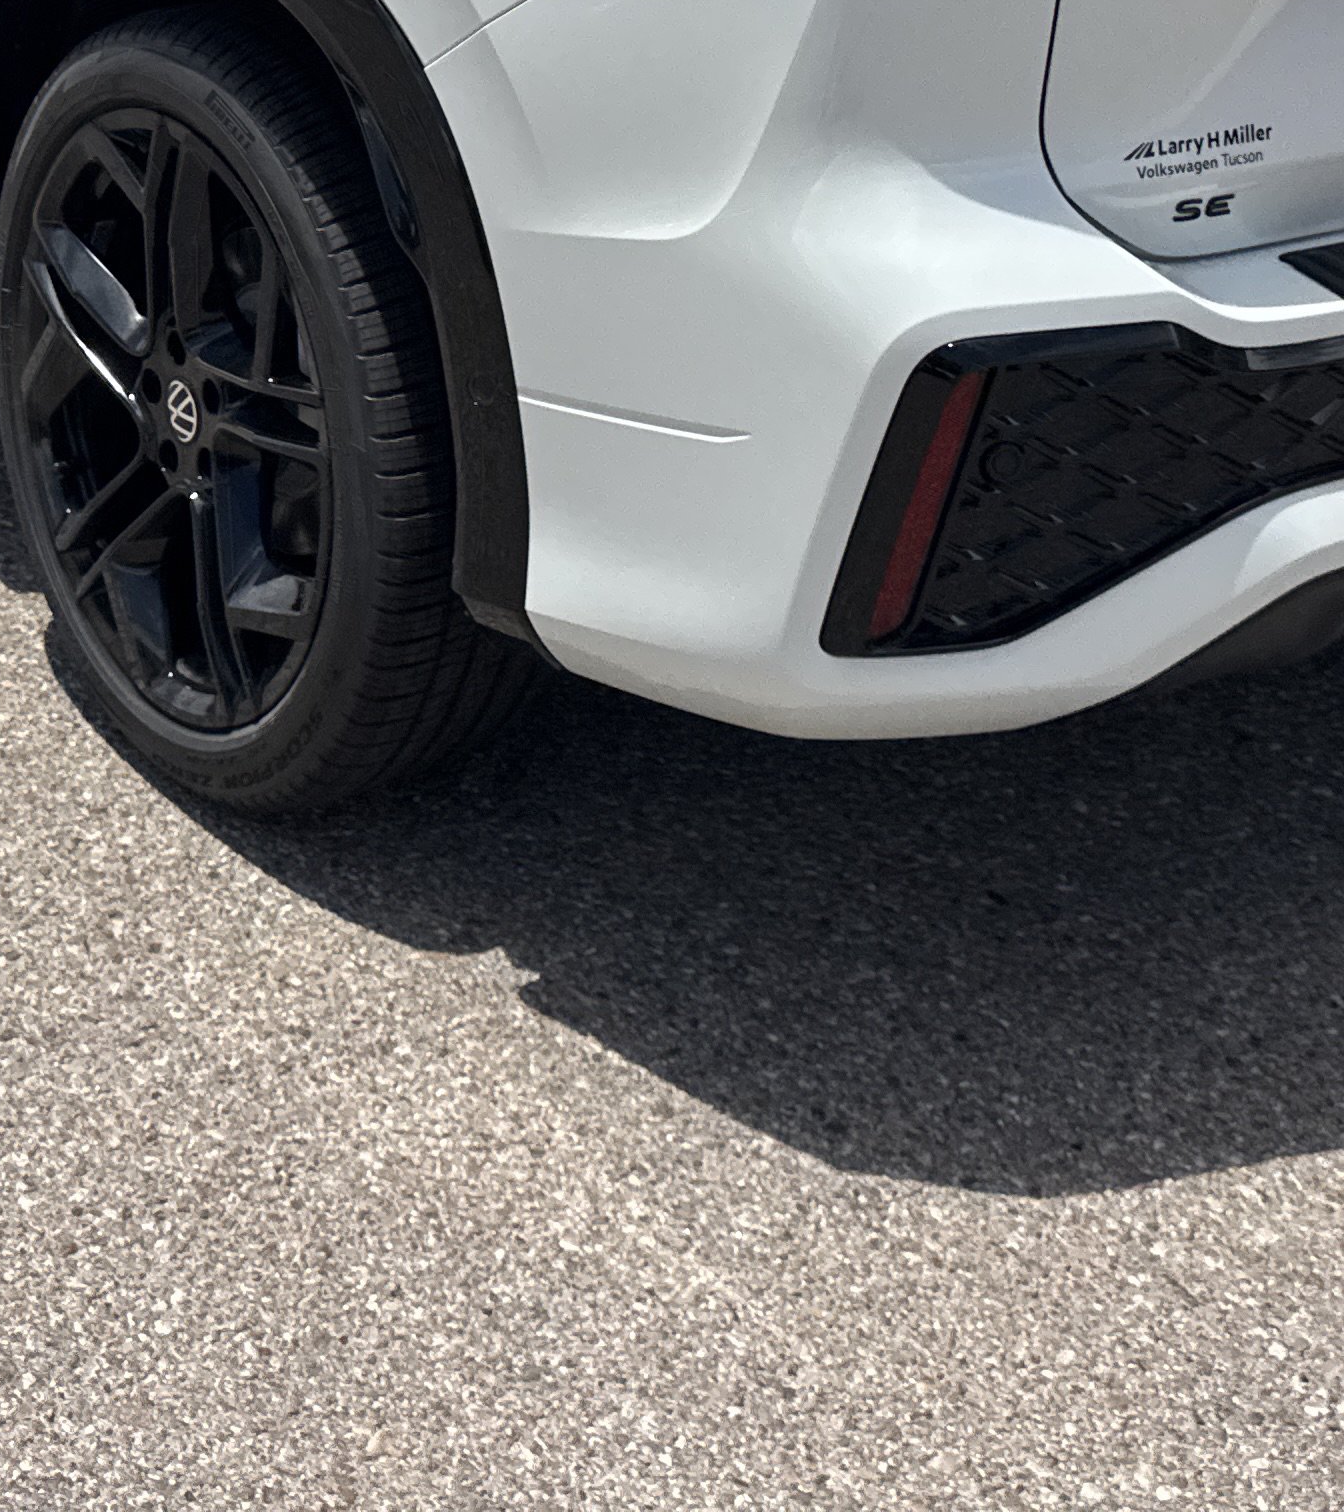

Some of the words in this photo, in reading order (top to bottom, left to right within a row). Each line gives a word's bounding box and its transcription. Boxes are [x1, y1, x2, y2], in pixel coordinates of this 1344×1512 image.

[1158, 136, 1204, 156] Larry
[1207, 132, 1220, 148] H
[1223, 124, 1272, 147] Miller
[1136, 158, 1219, 179] Volkswagen
[1221, 149, 1264, 167] Tucson
[1172, 194, 1235, 222] SE
